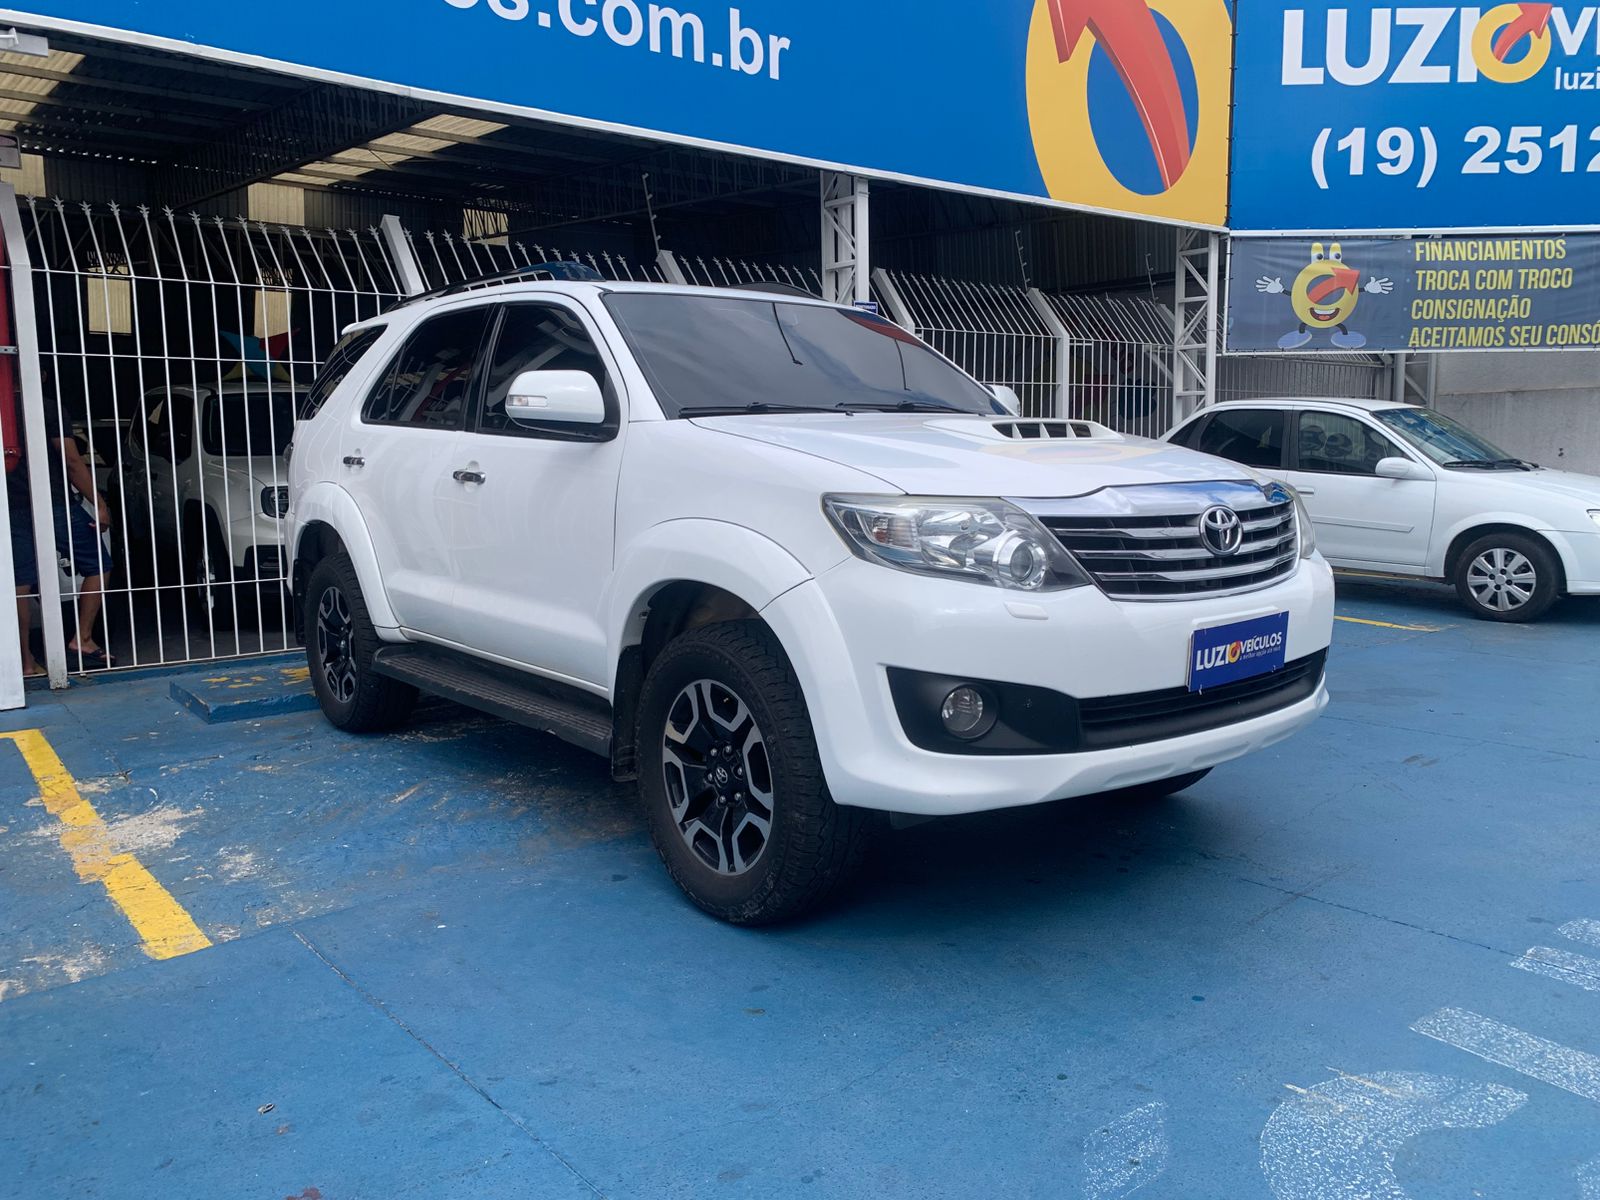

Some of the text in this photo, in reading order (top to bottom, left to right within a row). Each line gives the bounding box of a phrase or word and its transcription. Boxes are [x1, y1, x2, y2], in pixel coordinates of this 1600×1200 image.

[444, 0, 791, 80] .com.br
[1552, 7, 1600, 55] V
[1311, 127, 1438, 189] (19)
[1415, 239, 1566, 261] FINANCIAMENTOS
[1416, 267, 1573, 290] TROCA COM TROCO
[1411, 295, 1531, 322] CONSIGNAÇÃO
[1408, 326, 1505, 347] ACEITAMOS
[1508, 325, 1542, 346] SEU
